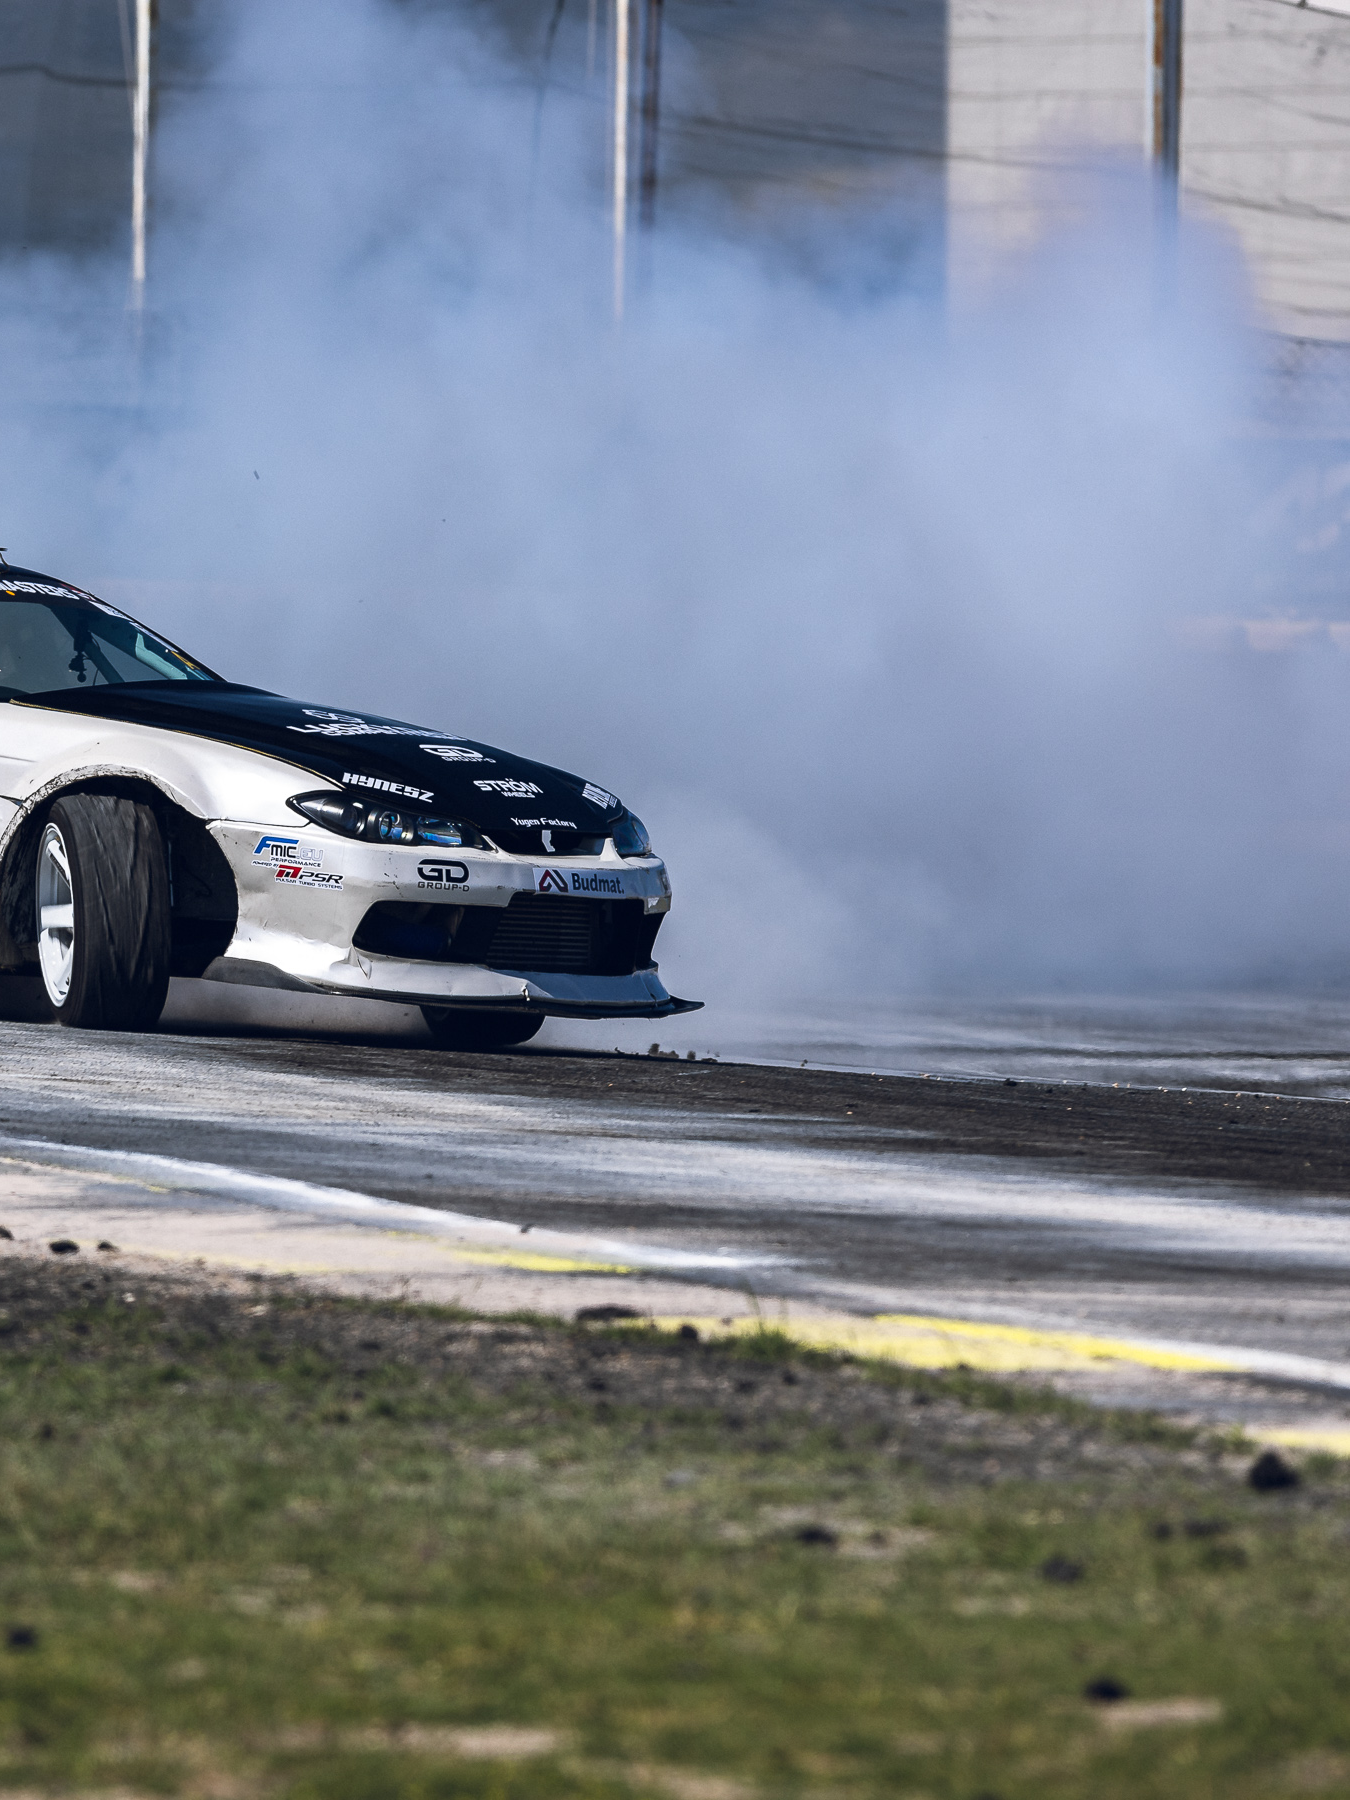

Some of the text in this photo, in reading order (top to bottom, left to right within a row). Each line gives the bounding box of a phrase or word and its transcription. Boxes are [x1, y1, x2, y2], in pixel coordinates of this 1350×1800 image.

[441, 756, 497, 764] GROUP-D
[342, 772, 435, 803] HYNESZ
[473, 778, 544, 794] STRÖM
[500, 791, 536, 799] WHEELS
[510, 817, 577, 829] Yugen Factory
[270, 856, 322, 868] PERFORMANCE
[299, 870, 344, 885] PSR
[572, 873, 625, 894] Budmat.
[417, 881, 471, 892] GROUP-D
